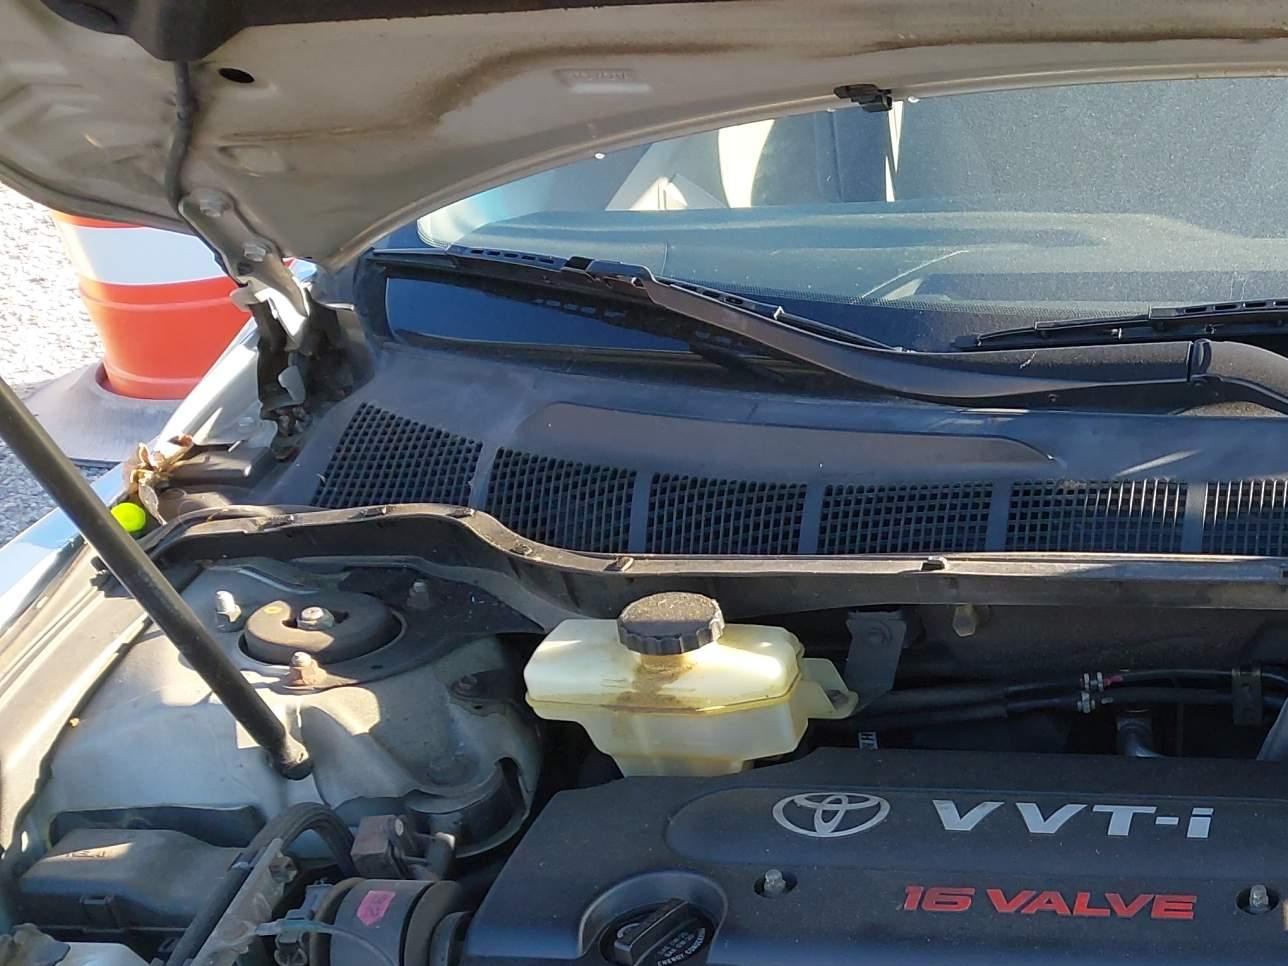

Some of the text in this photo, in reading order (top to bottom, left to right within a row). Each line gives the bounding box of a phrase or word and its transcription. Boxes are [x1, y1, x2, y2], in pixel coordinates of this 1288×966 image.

[932, 798, 1214, 840] VVT-i
[905, 885, 1198, 921] 16 VALVE
